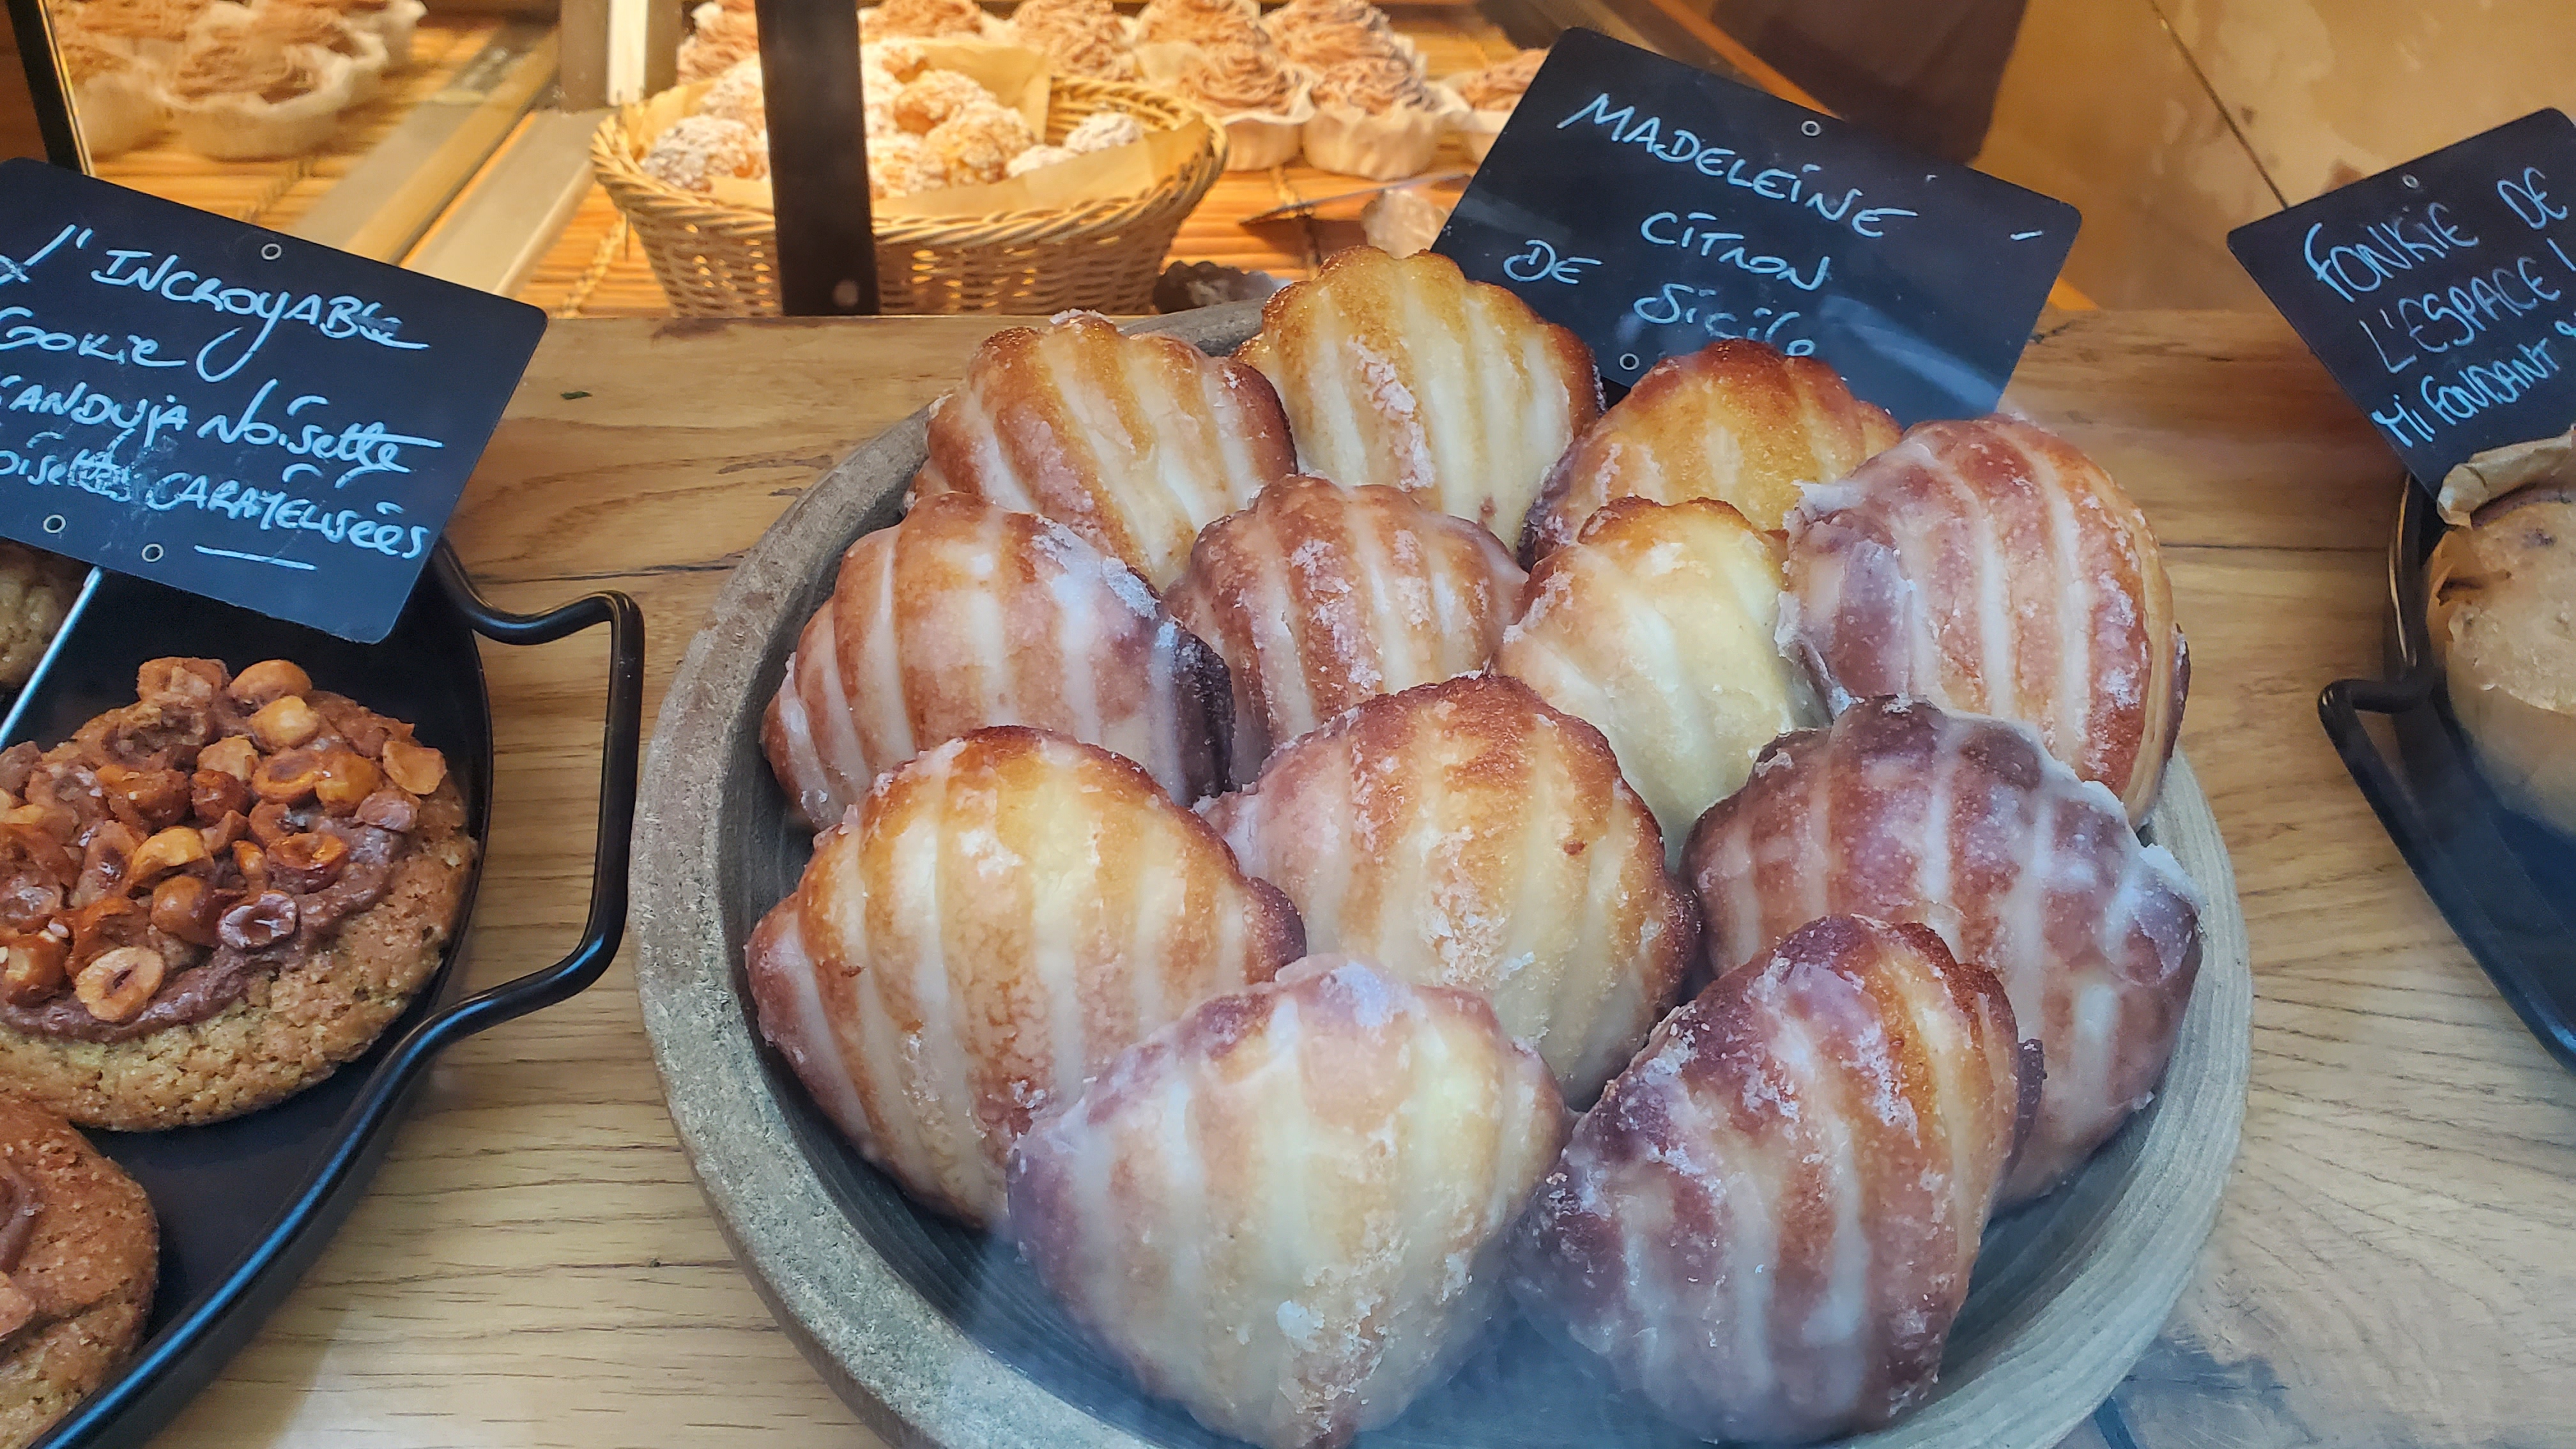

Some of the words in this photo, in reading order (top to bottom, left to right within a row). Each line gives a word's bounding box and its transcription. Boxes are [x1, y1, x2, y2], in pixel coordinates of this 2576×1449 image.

[1556, 92, 1919, 239] MADELEINE
[2497, 166, 2568, 231] DE
[1503, 239, 1604, 284] DE
[1640, 211, 1831, 291] CITRON
